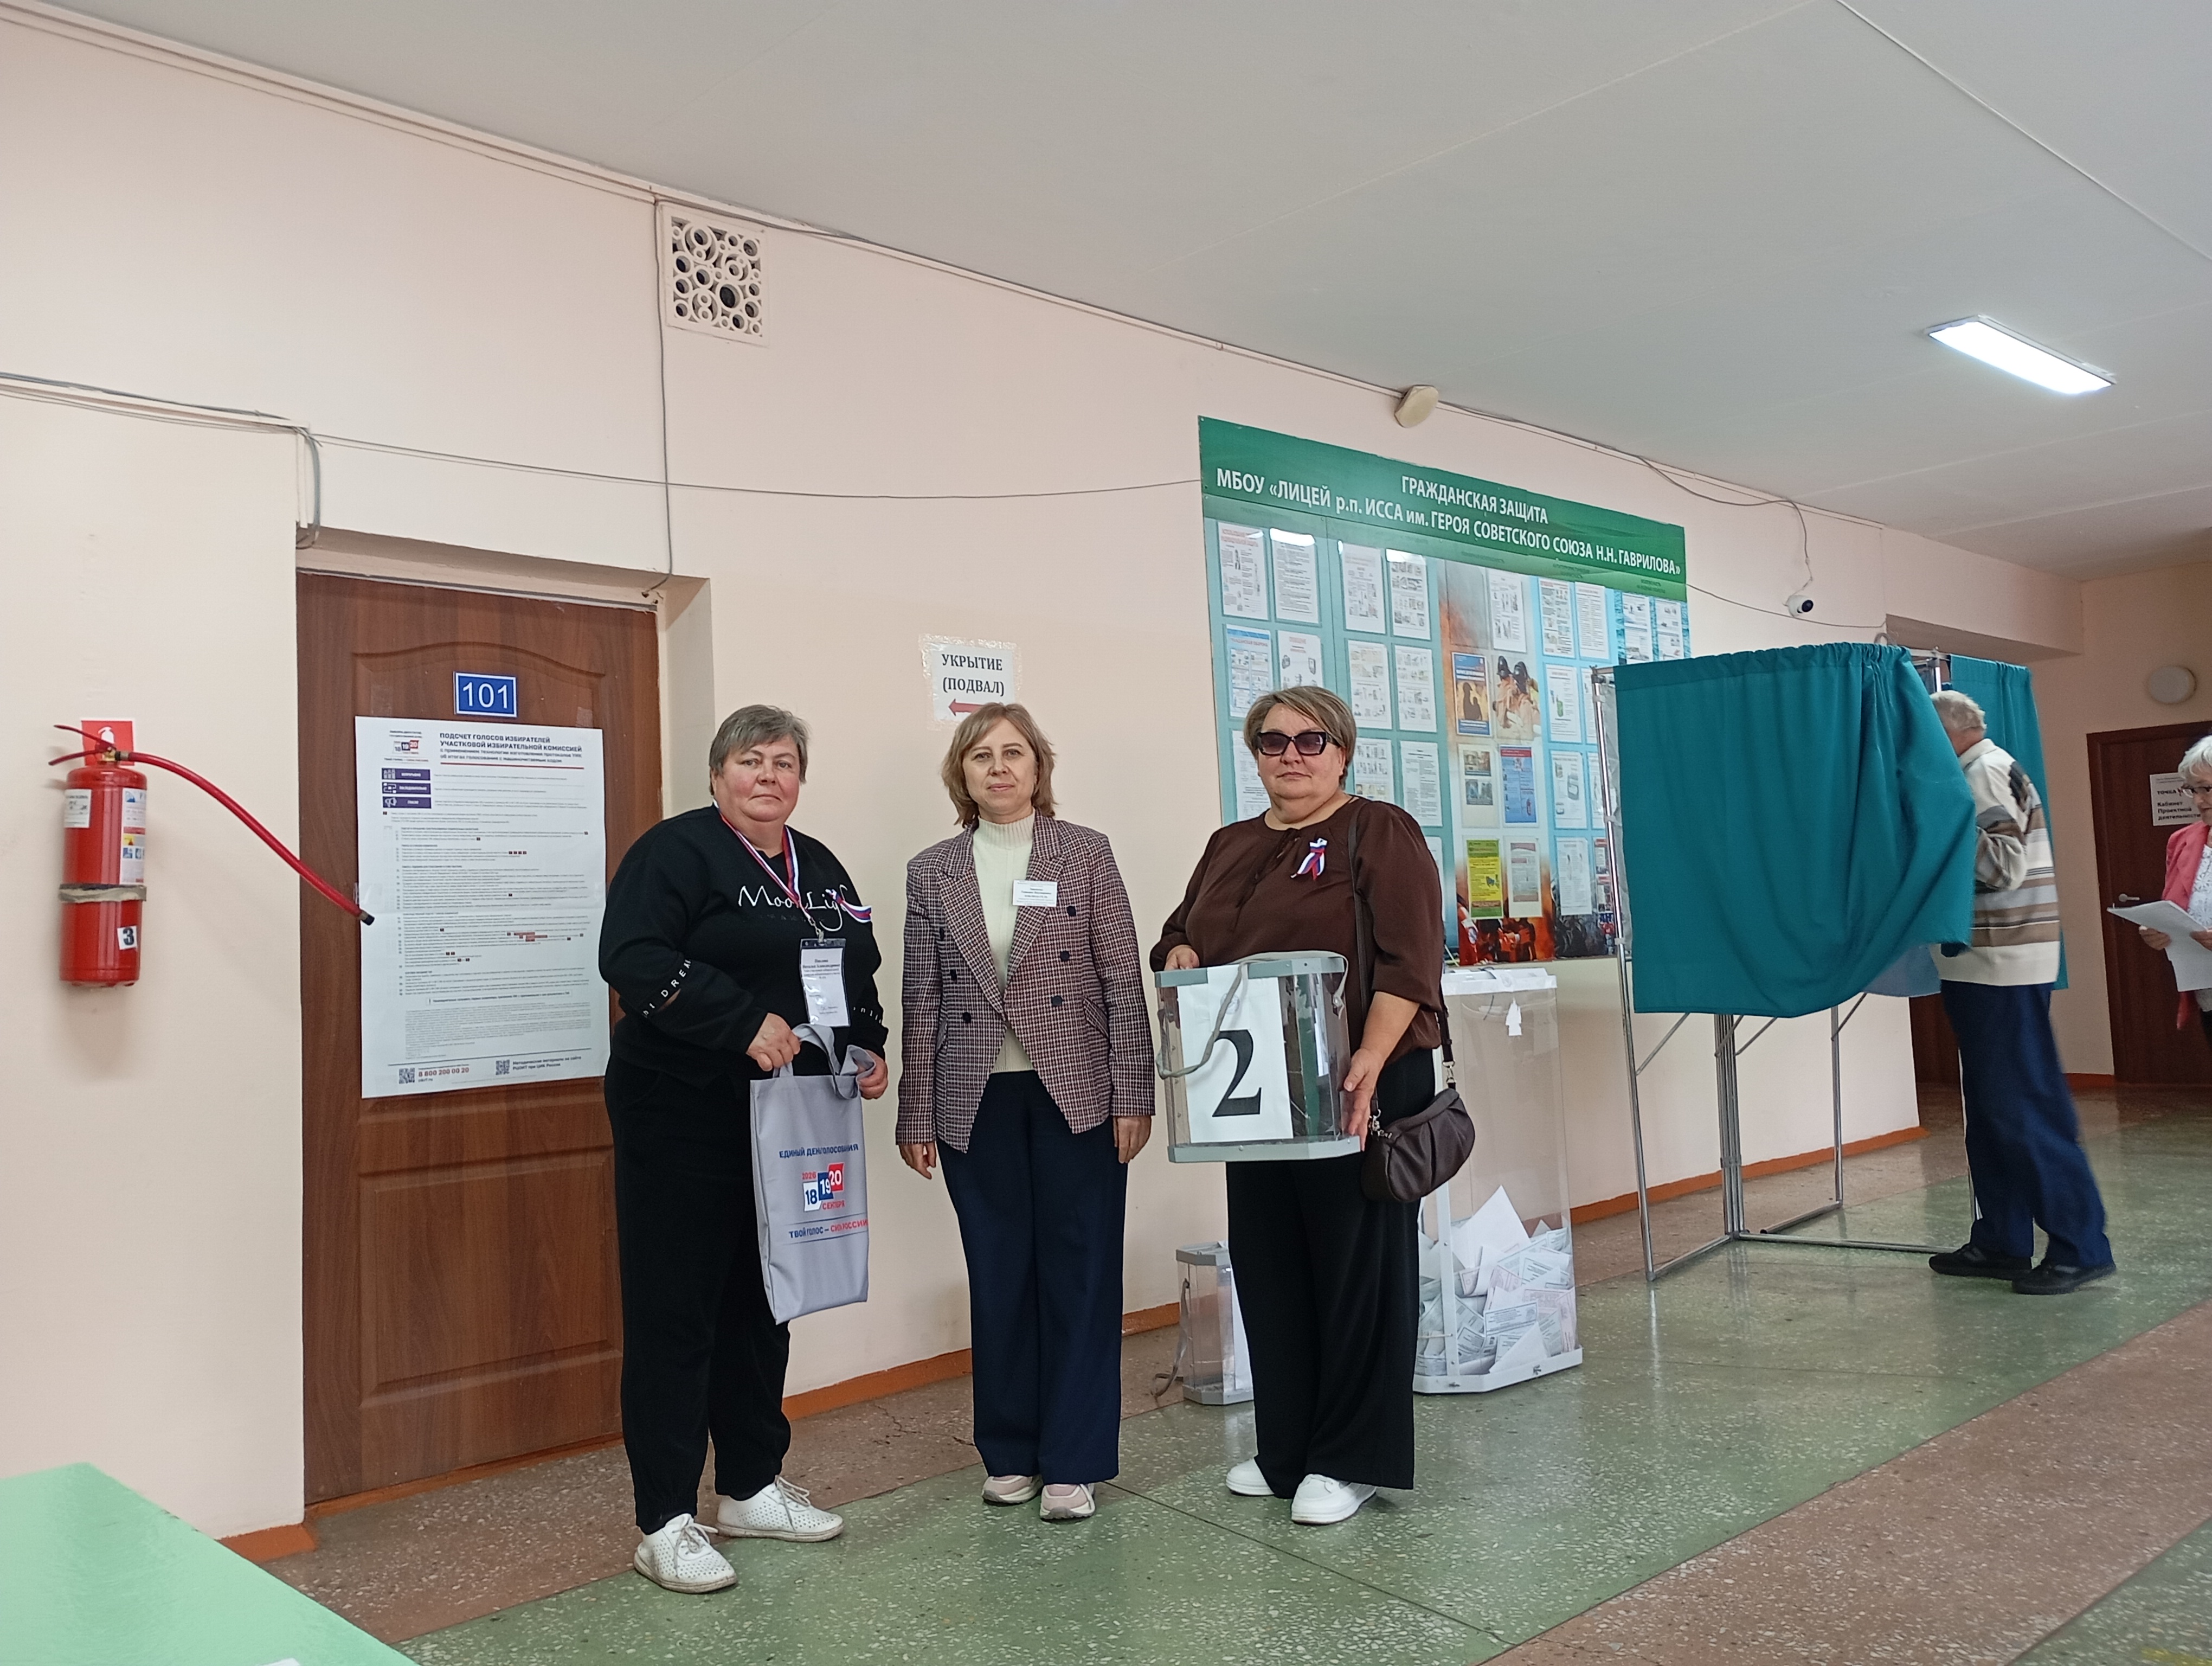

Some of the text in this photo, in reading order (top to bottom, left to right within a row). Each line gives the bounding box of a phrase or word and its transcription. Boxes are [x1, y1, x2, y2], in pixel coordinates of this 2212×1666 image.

[1401, 475, 1548, 524] ГРАЖДАНСКАЯ ЗАЩИТА
[1217, 467, 1681, 575] МБОУ «ЛИЦЕЙ р.п. ИССА им. ГЕРОЯ СОВЕТСКОГО СОЮЗА Н.Н. ГАВРИЛОВА»
[942, 654, 1002, 671] УКРЫТИЕ
[462, 682, 509, 709] 101
[943, 677, 1004, 697] (ПОДВАЛ)
[487, 742, 542, 751] ИЗБИРАТЕЛЬНОЙ
[543, 744, 582, 752] КОМИССИЕЙ
[738, 885, 848, 931] Moo Lig
[123, 928, 134, 946] 3
[1212, 1029, 1262, 1117] 2
[779, 1147, 805, 1158] ЕДИНЫЙ
[828, 1169, 842, 1186] 20
[820, 1178, 831, 1195] 19
[806, 1189, 818, 1206] 18
[789, 1227, 807, 1238] ТВОЙ
